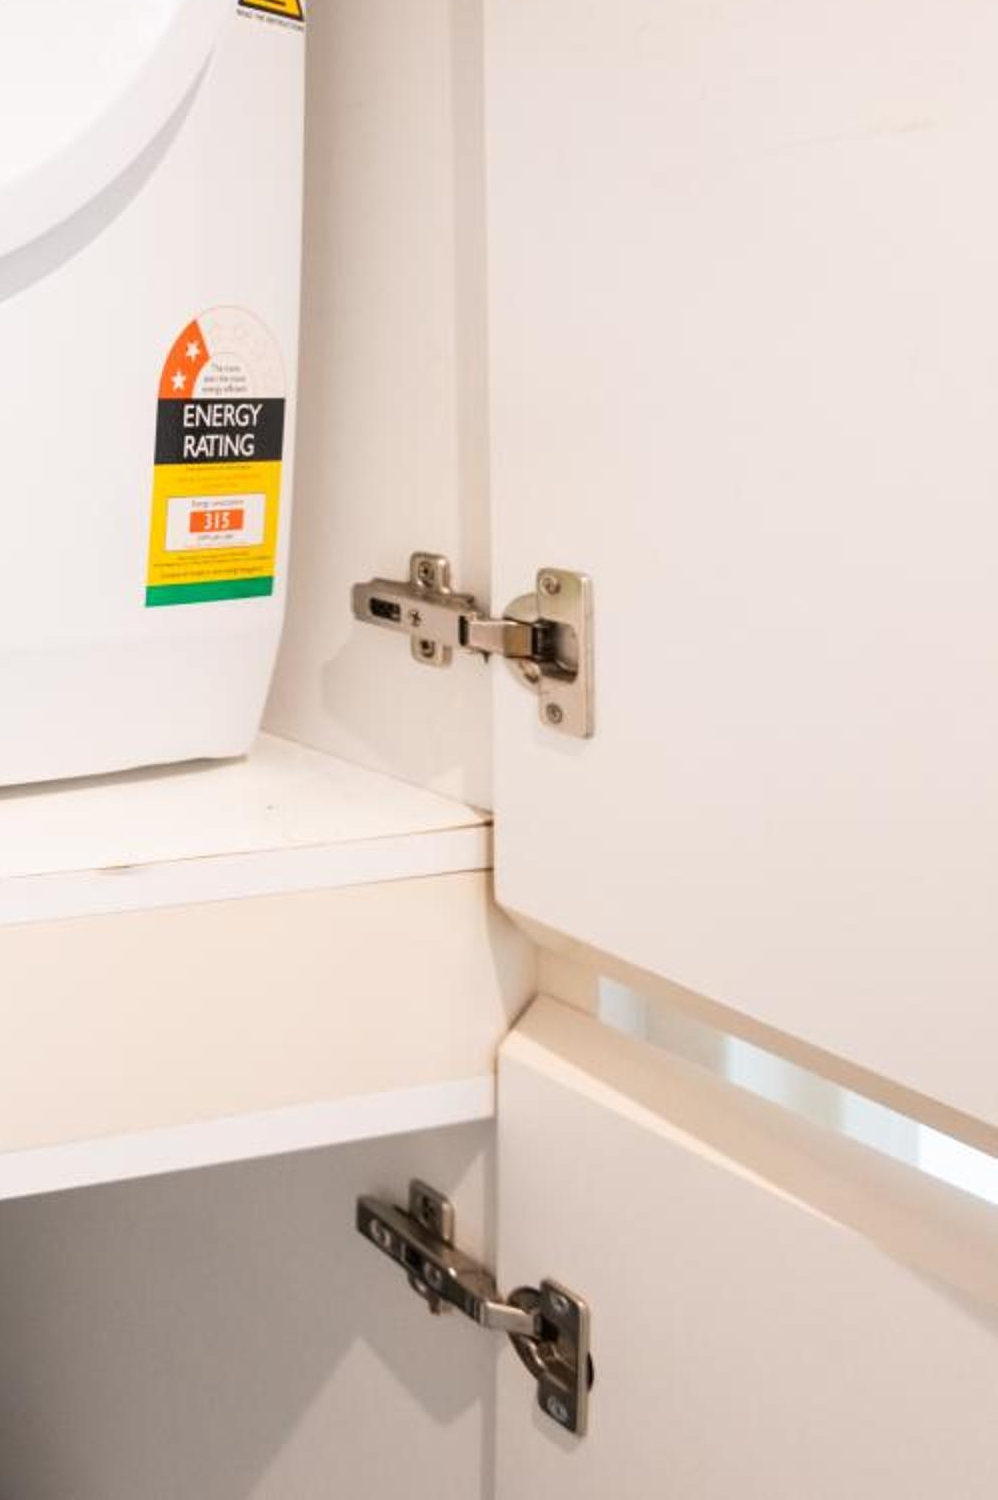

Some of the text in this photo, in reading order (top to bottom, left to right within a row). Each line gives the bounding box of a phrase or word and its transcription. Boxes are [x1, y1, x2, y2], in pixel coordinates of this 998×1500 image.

[183, 403, 263, 428] ENERGY
[183, 433, 256, 459] RATING
[203, 511, 231, 531] 315
